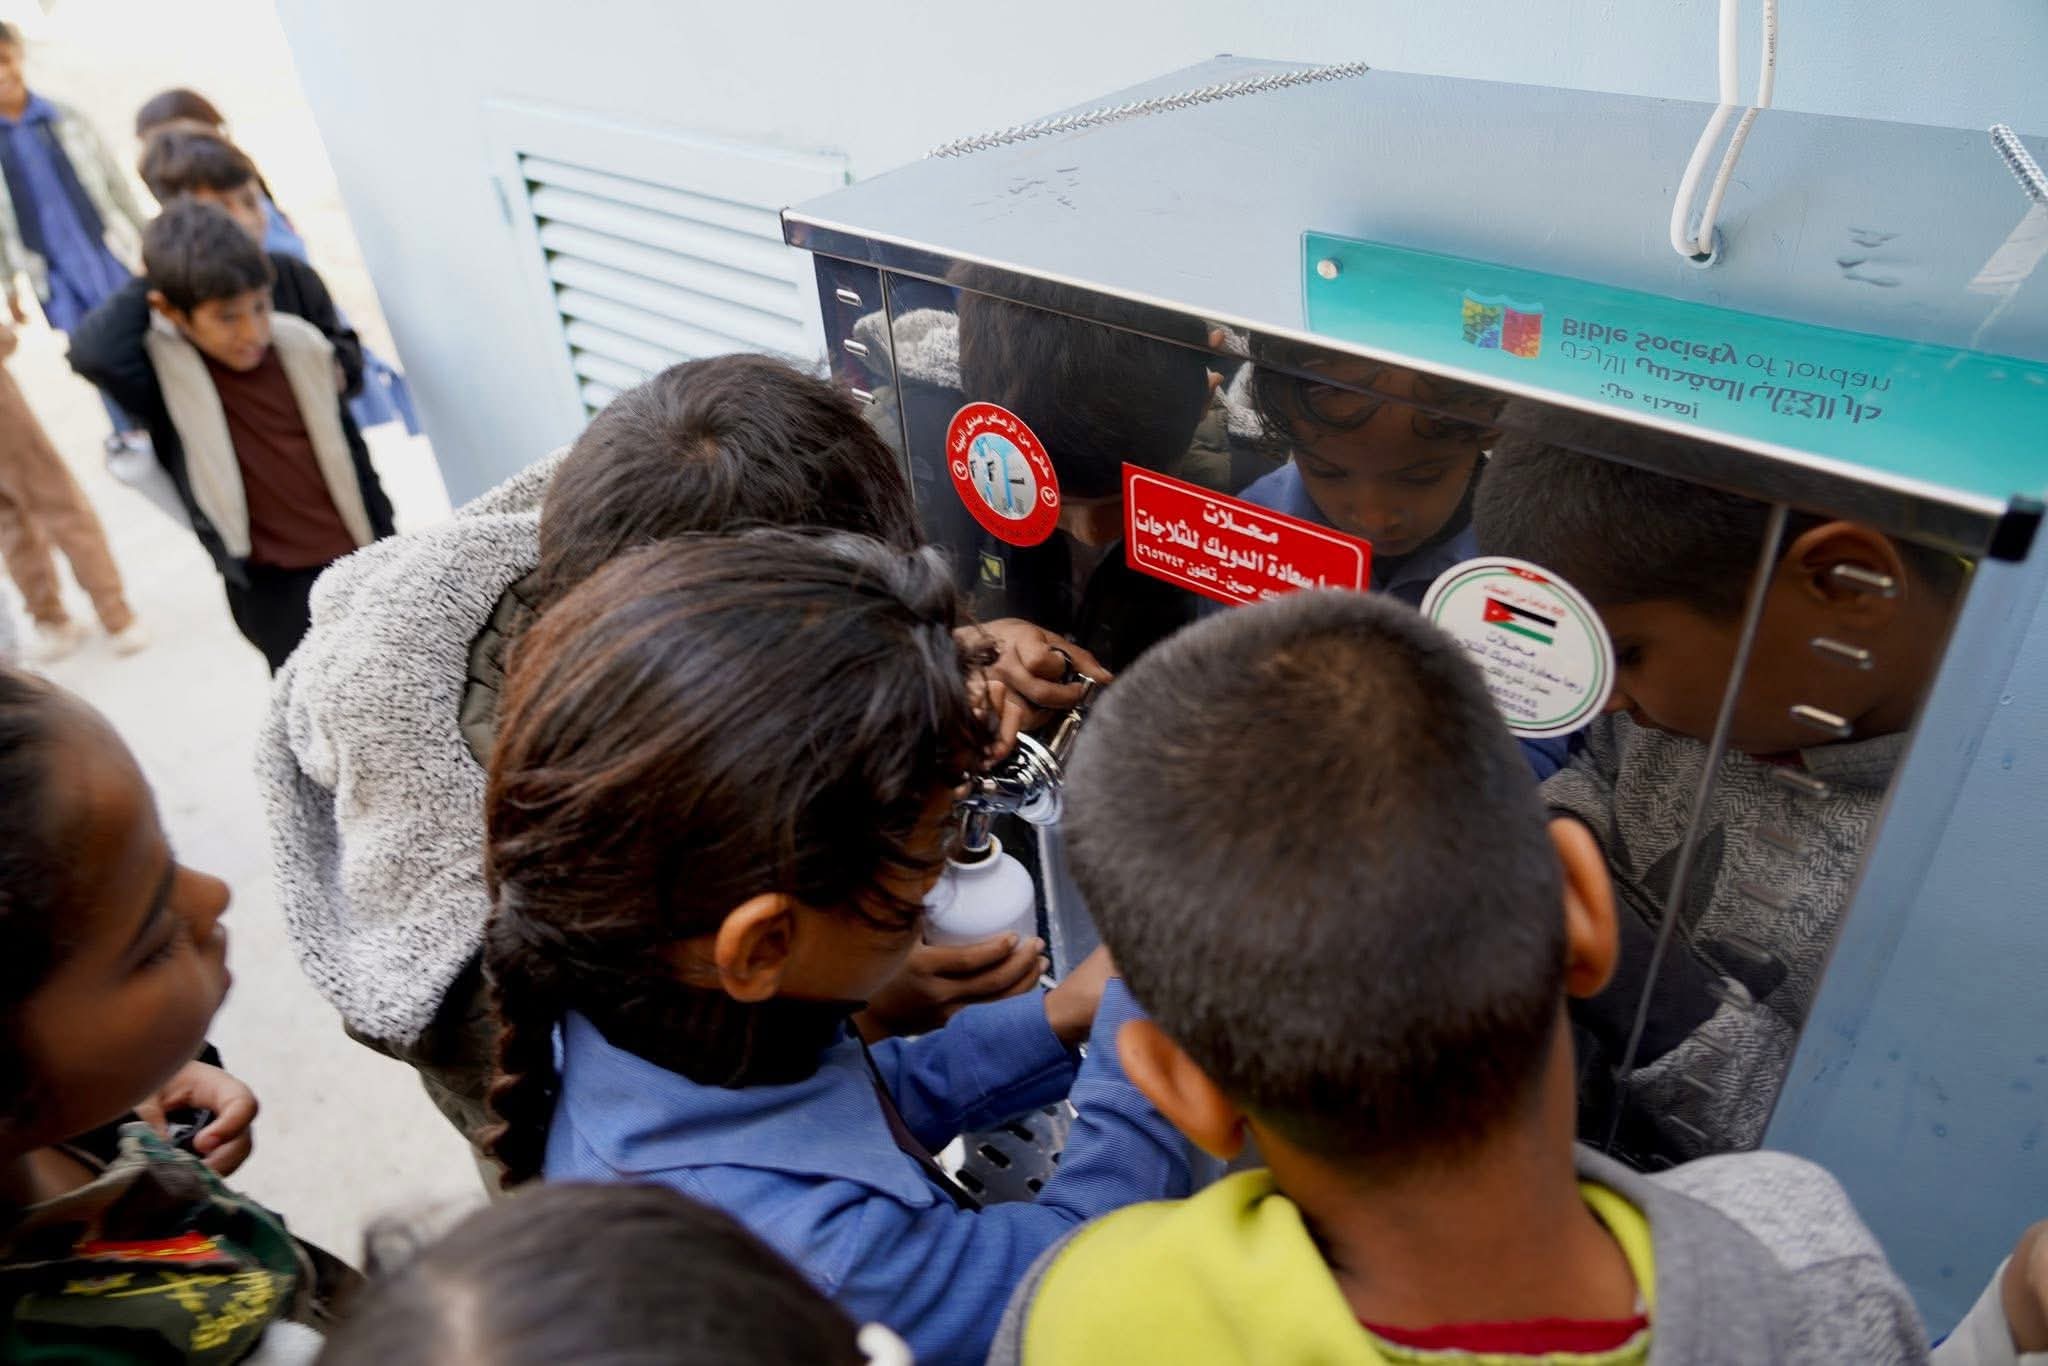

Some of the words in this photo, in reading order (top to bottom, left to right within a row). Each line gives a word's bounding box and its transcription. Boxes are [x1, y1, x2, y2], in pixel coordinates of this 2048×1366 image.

[1136, 508, 1200, 550] للثلاجات
[1186, 561, 1218, 582] تلفون
[1267, 553, 1314, 591] سعادة
